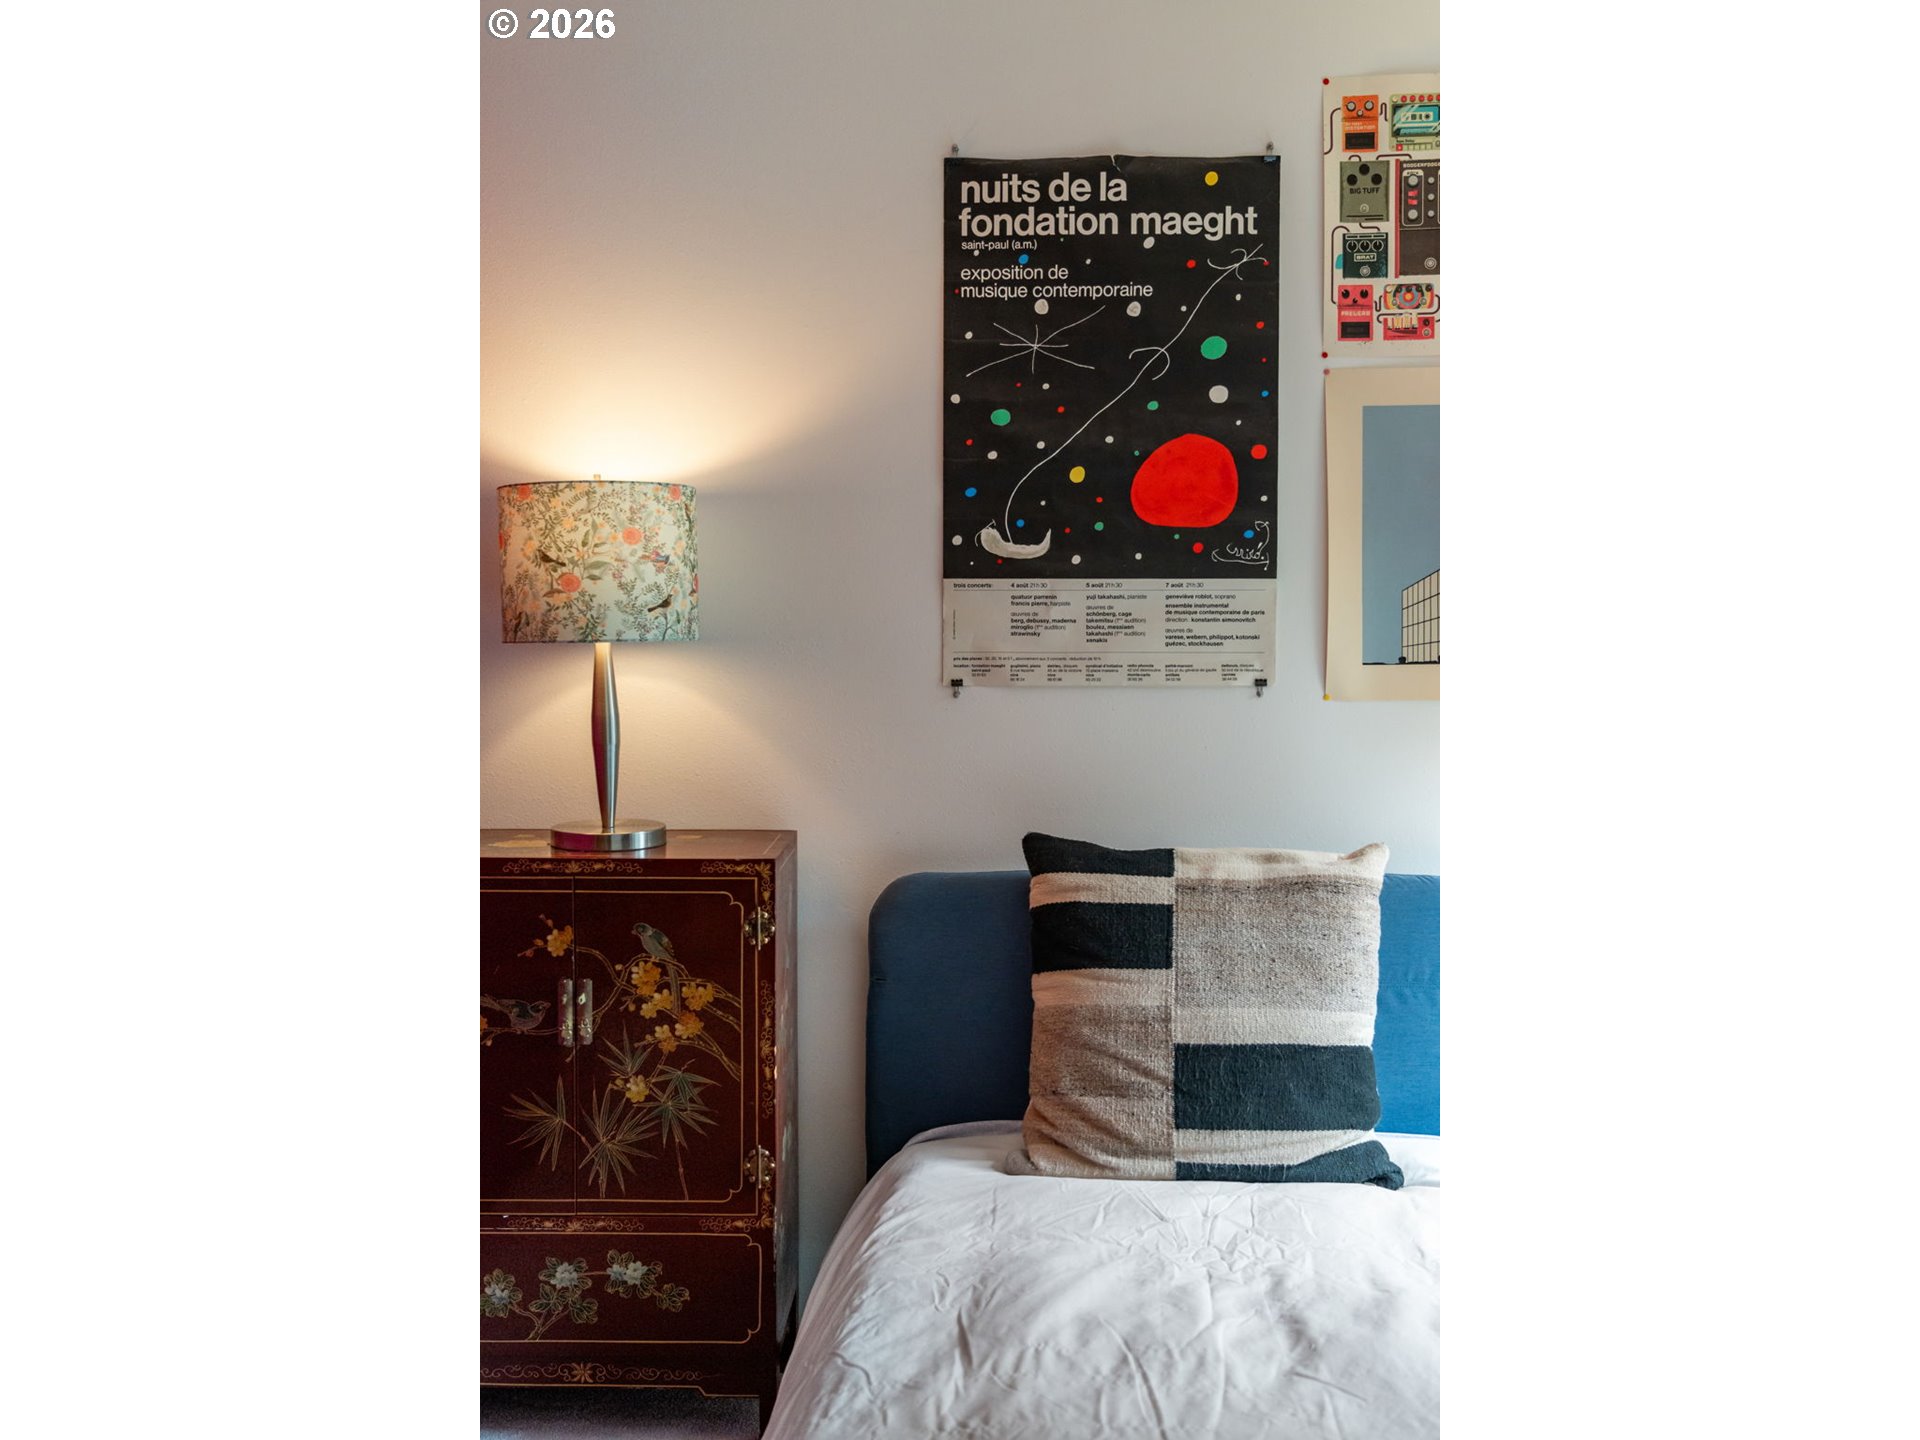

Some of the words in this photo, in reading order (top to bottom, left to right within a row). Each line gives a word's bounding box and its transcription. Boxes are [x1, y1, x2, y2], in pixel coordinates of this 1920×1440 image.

[961, 173, 1041, 203] nuits
[1048, 172, 1092, 203] de
[1100, 171, 1128, 202] la
[958, 206, 1118, 237] fondation
[1130, 206, 1258, 241] maeght
[961, 240, 1009, 250] saint-paul
[1012, 240, 1038, 250] (a.m.)
[960, 266, 1044, 282] exposition
[1048, 264, 1069, 280] de
[960, 285, 1028, 301] musique
[1032, 283, 1154, 300] contemporaine
